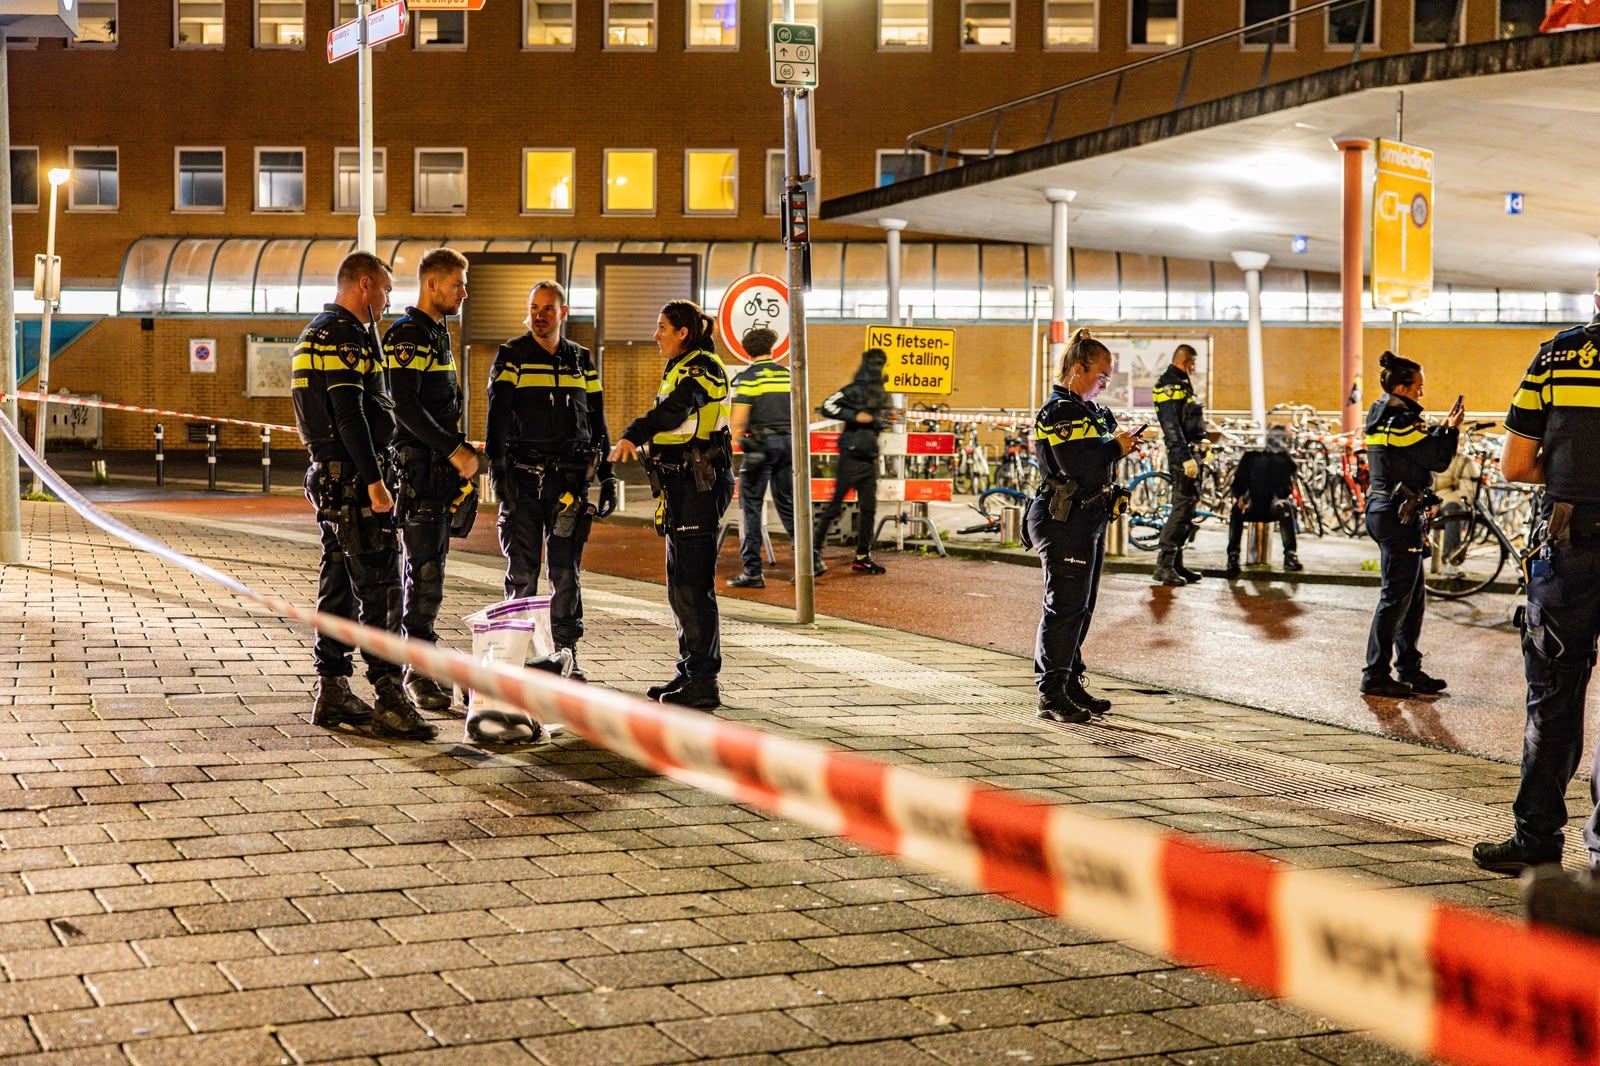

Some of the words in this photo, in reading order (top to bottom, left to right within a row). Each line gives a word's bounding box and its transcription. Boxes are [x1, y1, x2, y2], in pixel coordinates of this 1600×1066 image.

[1381, 146, 1431, 179] omleiding
[872, 332, 893, 347] NS
[896, 334, 950, 349] fietsen-
[900, 352, 950, 370] stalling
